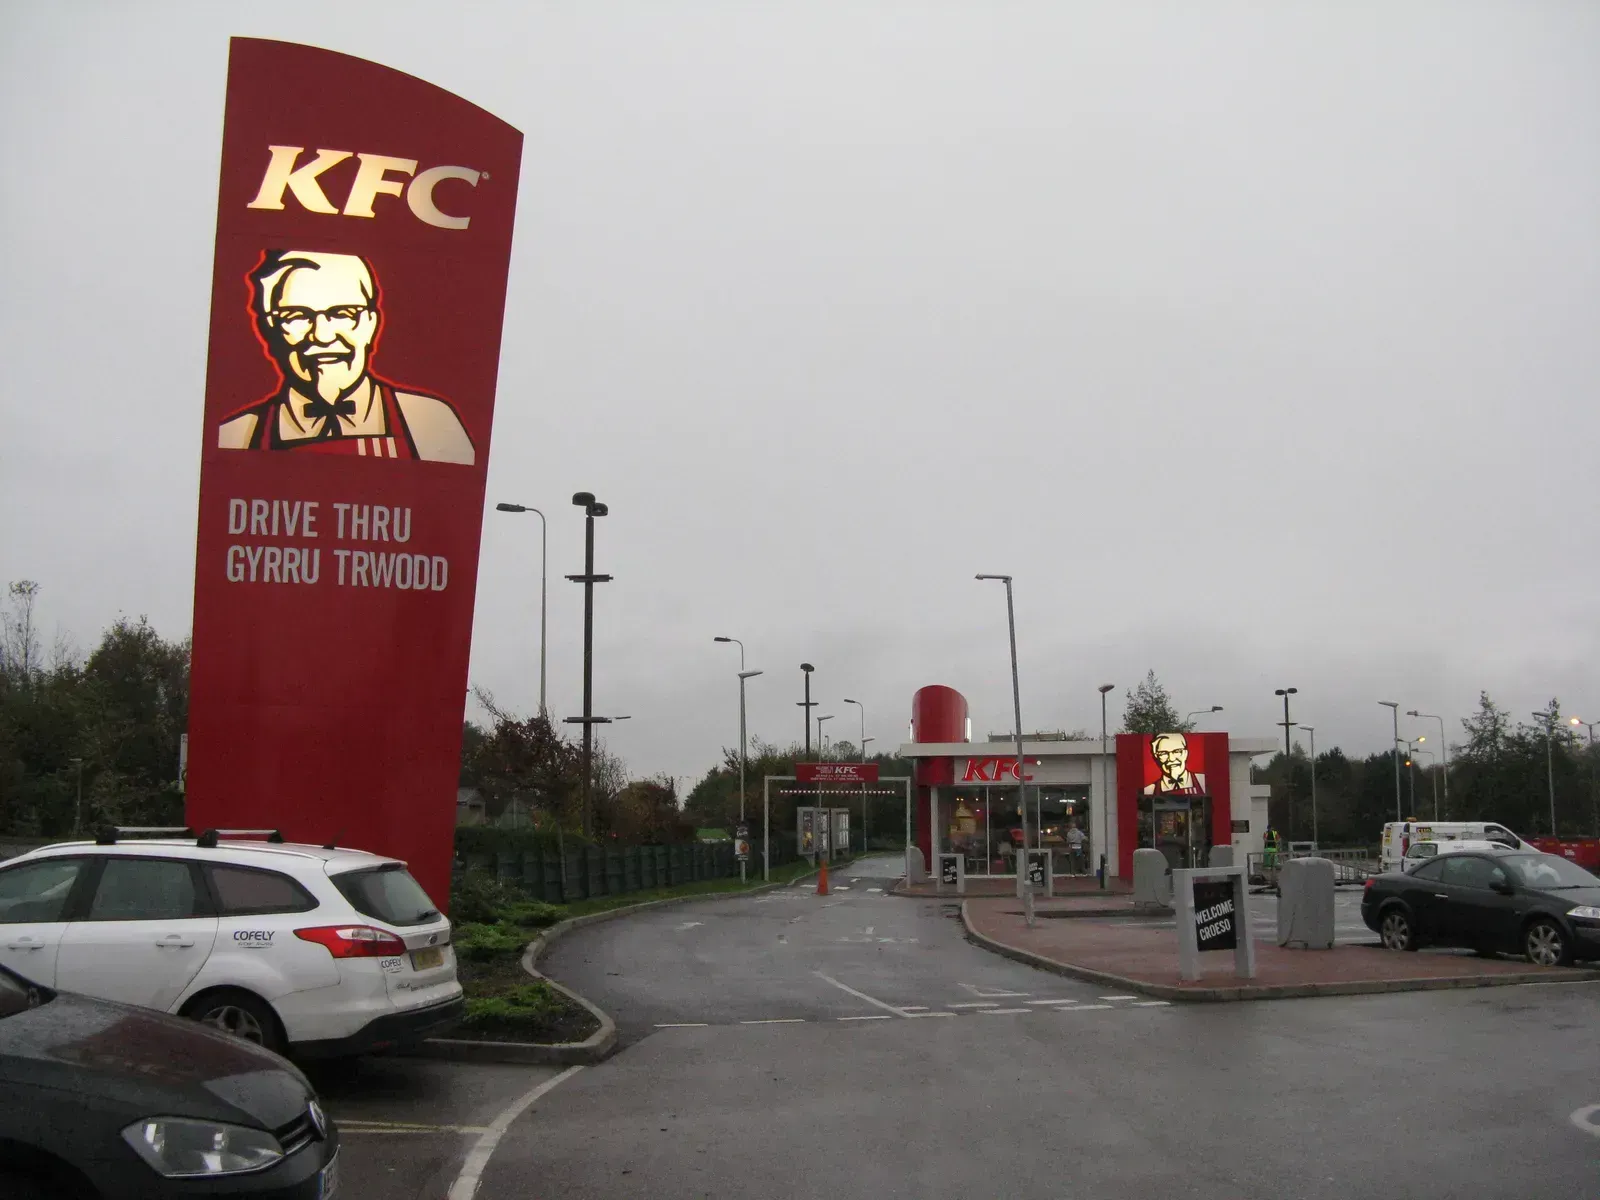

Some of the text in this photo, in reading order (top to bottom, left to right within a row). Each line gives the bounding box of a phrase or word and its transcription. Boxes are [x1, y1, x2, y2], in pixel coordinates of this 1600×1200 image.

[247, 145, 481, 230] KFC
[228, 497, 412, 543] DRIVE THRU
[226, 544, 449, 592] GYRRU TRWODD
[834, 766, 857, 774] KFC
[962, 757, 1037, 782] KFC
[1194, 899, 1235, 925] WELCOME
[233, 930, 275, 941] COFELY
[1199, 918, 1231, 941] CROESO
[380, 958, 402, 969] COFELY
